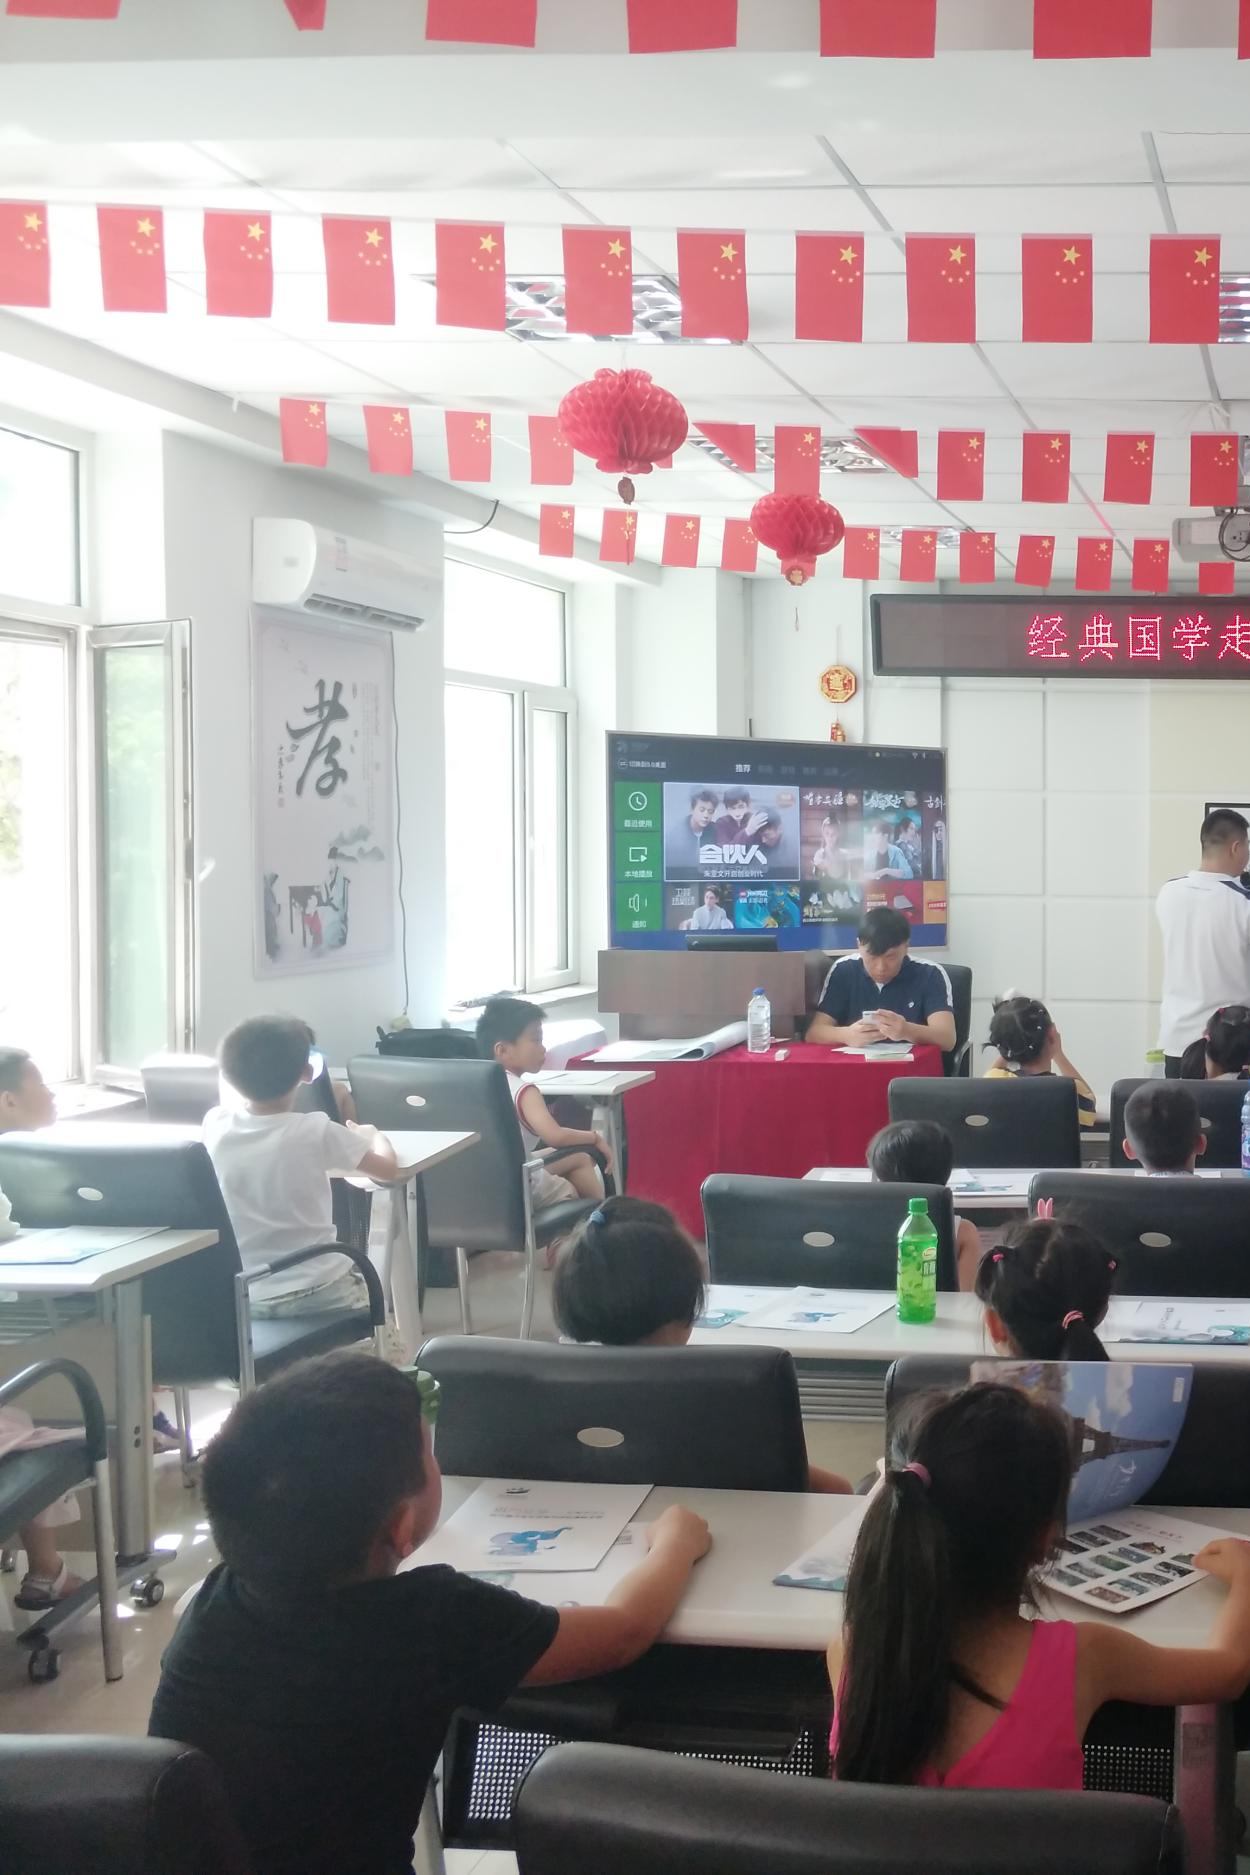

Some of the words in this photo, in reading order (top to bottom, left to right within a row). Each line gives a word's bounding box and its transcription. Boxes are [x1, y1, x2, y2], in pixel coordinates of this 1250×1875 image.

[285, 678, 350, 798] 孝
[699, 844, 767, 865] 合伙人
